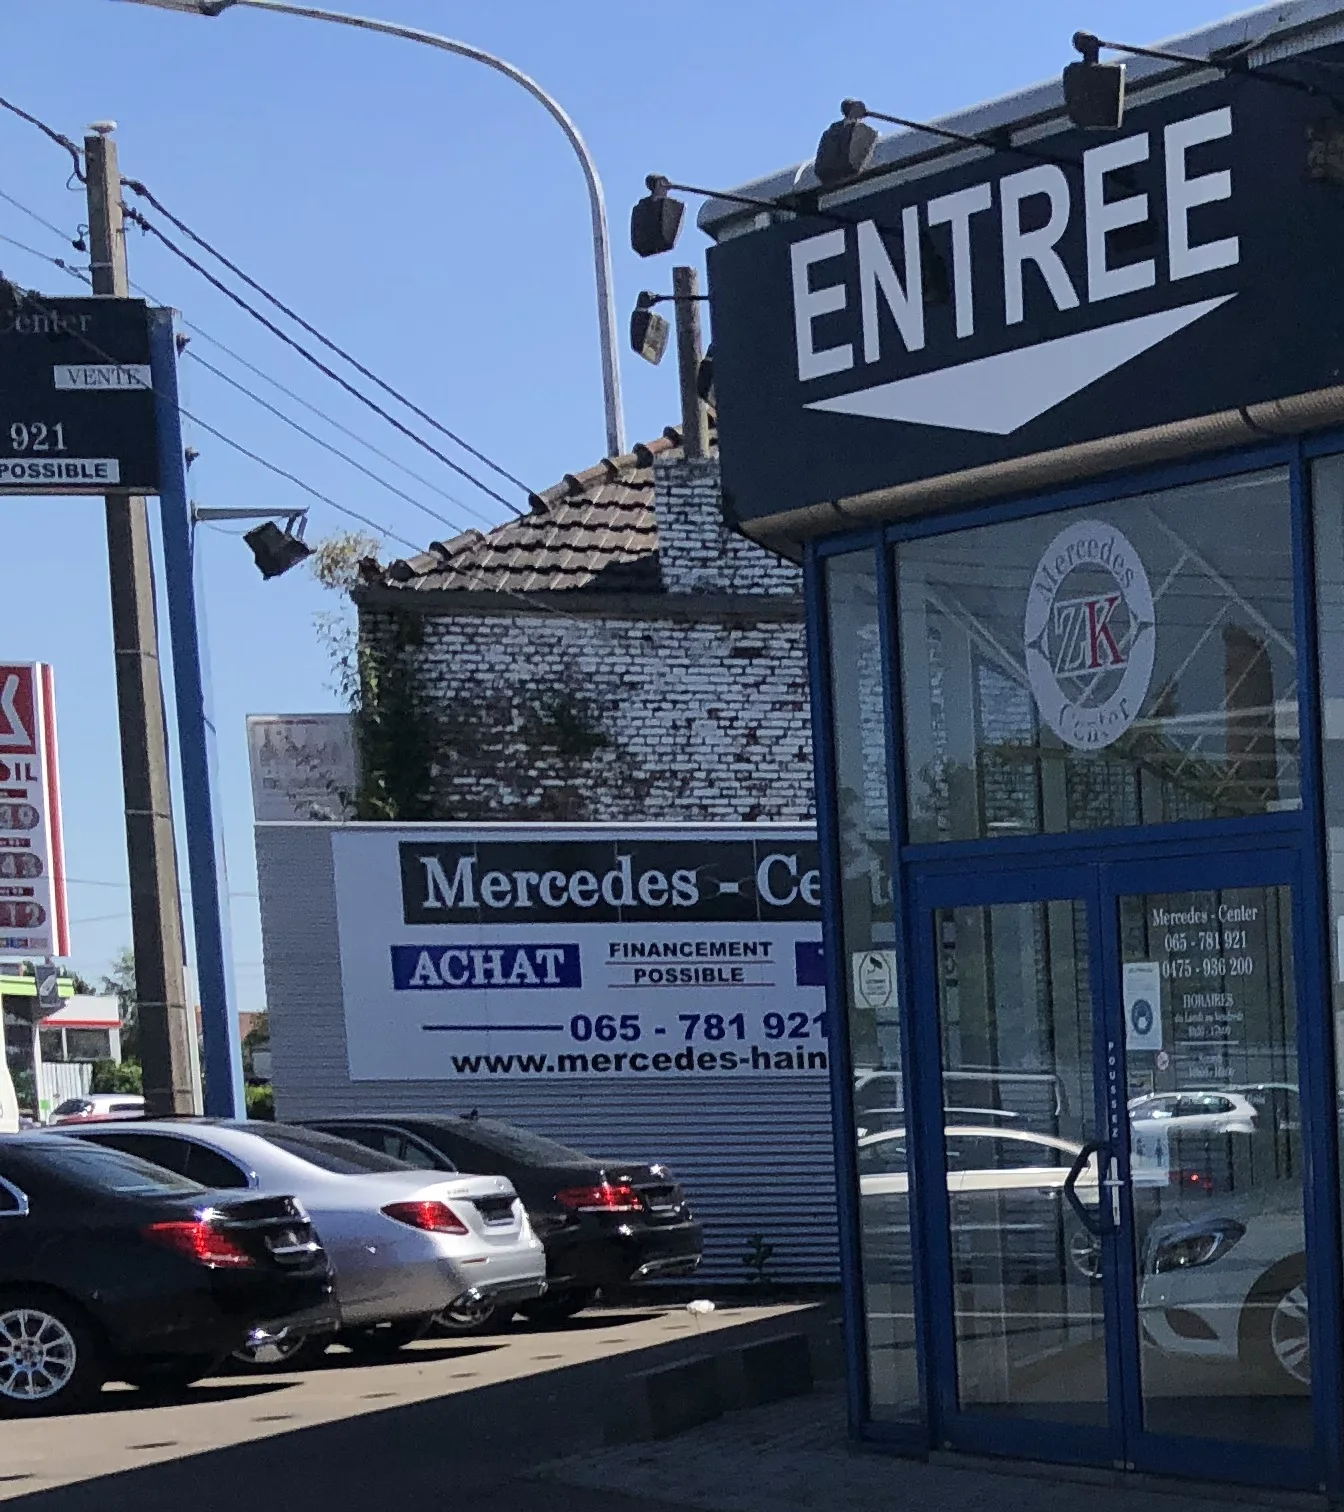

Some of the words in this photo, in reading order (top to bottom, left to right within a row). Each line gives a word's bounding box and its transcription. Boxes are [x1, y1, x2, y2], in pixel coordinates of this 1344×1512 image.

[790, 106, 1240, 382] ENTREE
[67, 367, 142, 385] VENTE
[10, 422, 67, 451] 921
[1035, 537, 1136, 600] Mercedes
[419, 855, 701, 908] Mercedes
[719, 881, 740, 895] -
[1152, 906, 1208, 926] Mercedes
[1218, 904, 1258, 922] Center
[609, 941, 773, 958] FINANCEMENT
[1164, 932, 1187, 952] 065
[1199, 930, 1220, 950] 781
[1224, 930, 1246, 949] 921
[409, 948, 566, 986] ACHAT
[634, 967, 744, 984] POSSIBLE
[1229, 956, 1253, 977] 200
[570, 1013, 642, 1042] 065
[654, 1027, 666, 1036] -
[678, 1012, 745, 1041] 781
[763, 1011, 828, 1040] 921
[451, 1045, 828, 1074] www.mercedes-hain
